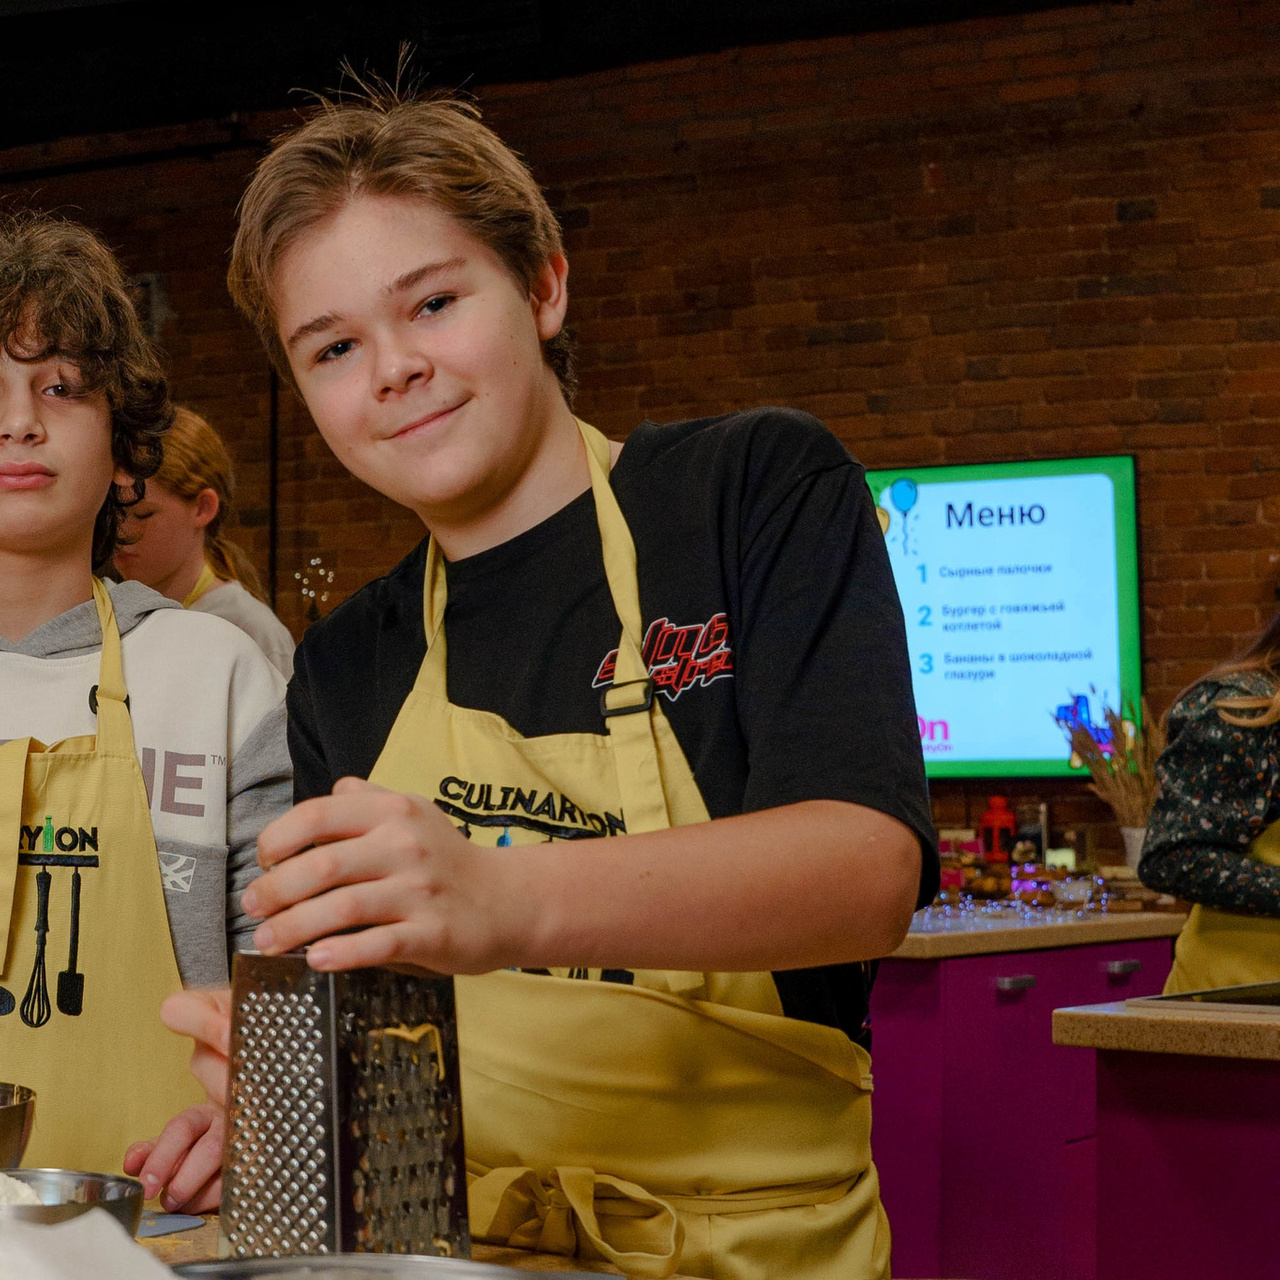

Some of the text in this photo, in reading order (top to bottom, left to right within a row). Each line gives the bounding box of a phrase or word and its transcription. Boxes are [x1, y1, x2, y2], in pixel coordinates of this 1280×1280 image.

[946, 501, 1046, 529] Меню
[917, 563, 927, 584] 1
[918, 605, 933, 627] 2
[919, 652, 934, 675] 3
